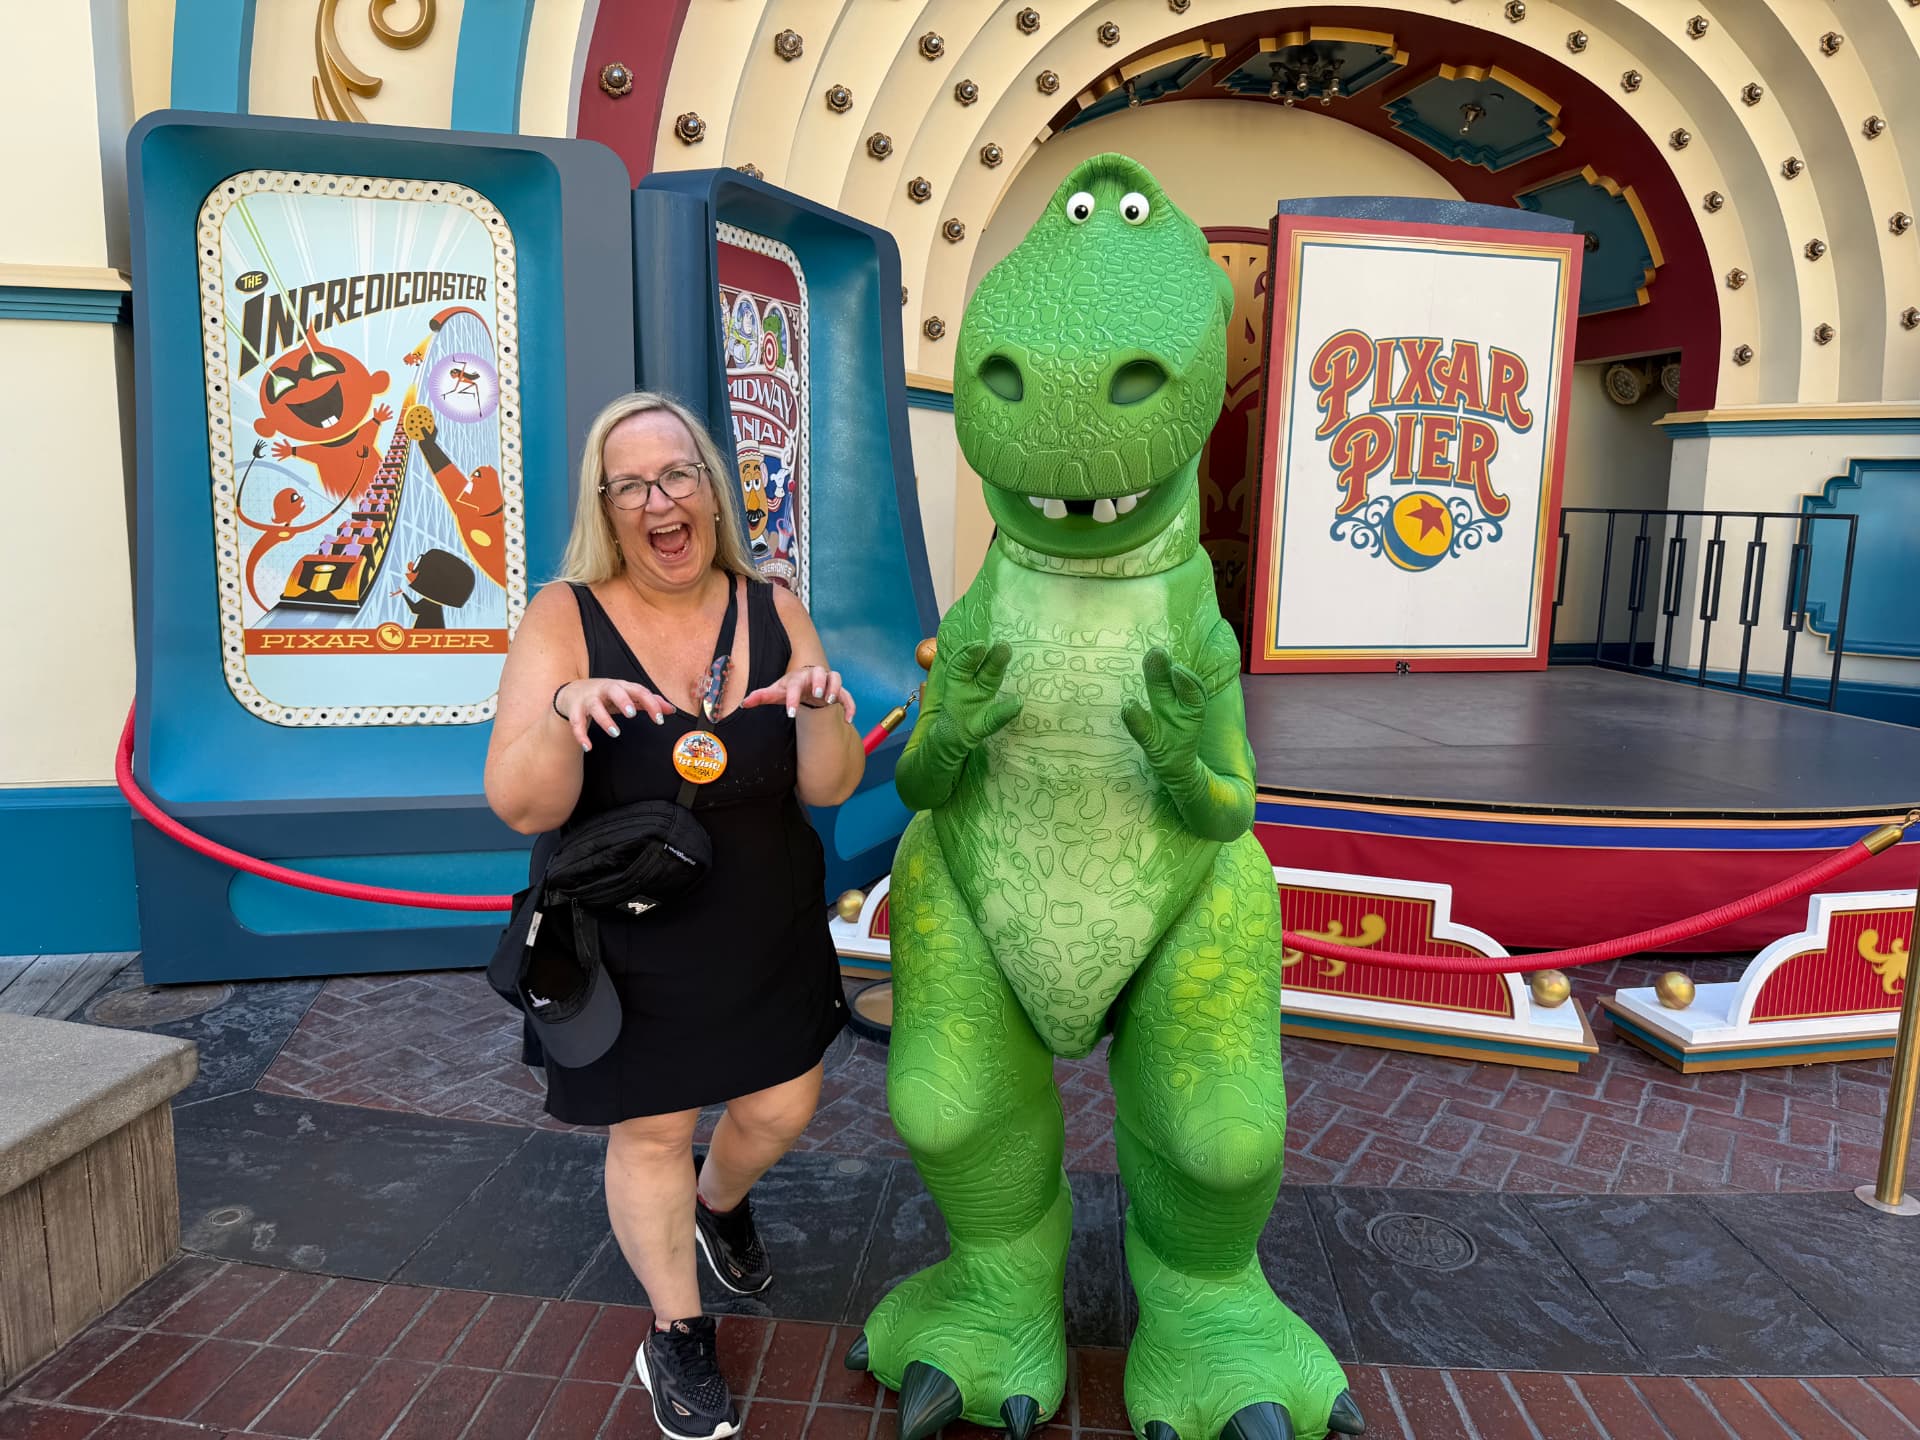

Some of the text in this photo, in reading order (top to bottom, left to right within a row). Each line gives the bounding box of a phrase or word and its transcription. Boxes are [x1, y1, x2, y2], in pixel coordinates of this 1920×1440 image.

[238, 271, 488, 381] THE INCREDICOASTER
[728, 378, 793, 425] MIDWAY
[1308, 328, 1534, 442] PIXAR
[1329, 412, 1511, 522] PIER
[260, 633, 494, 649] PIXAR PIER
